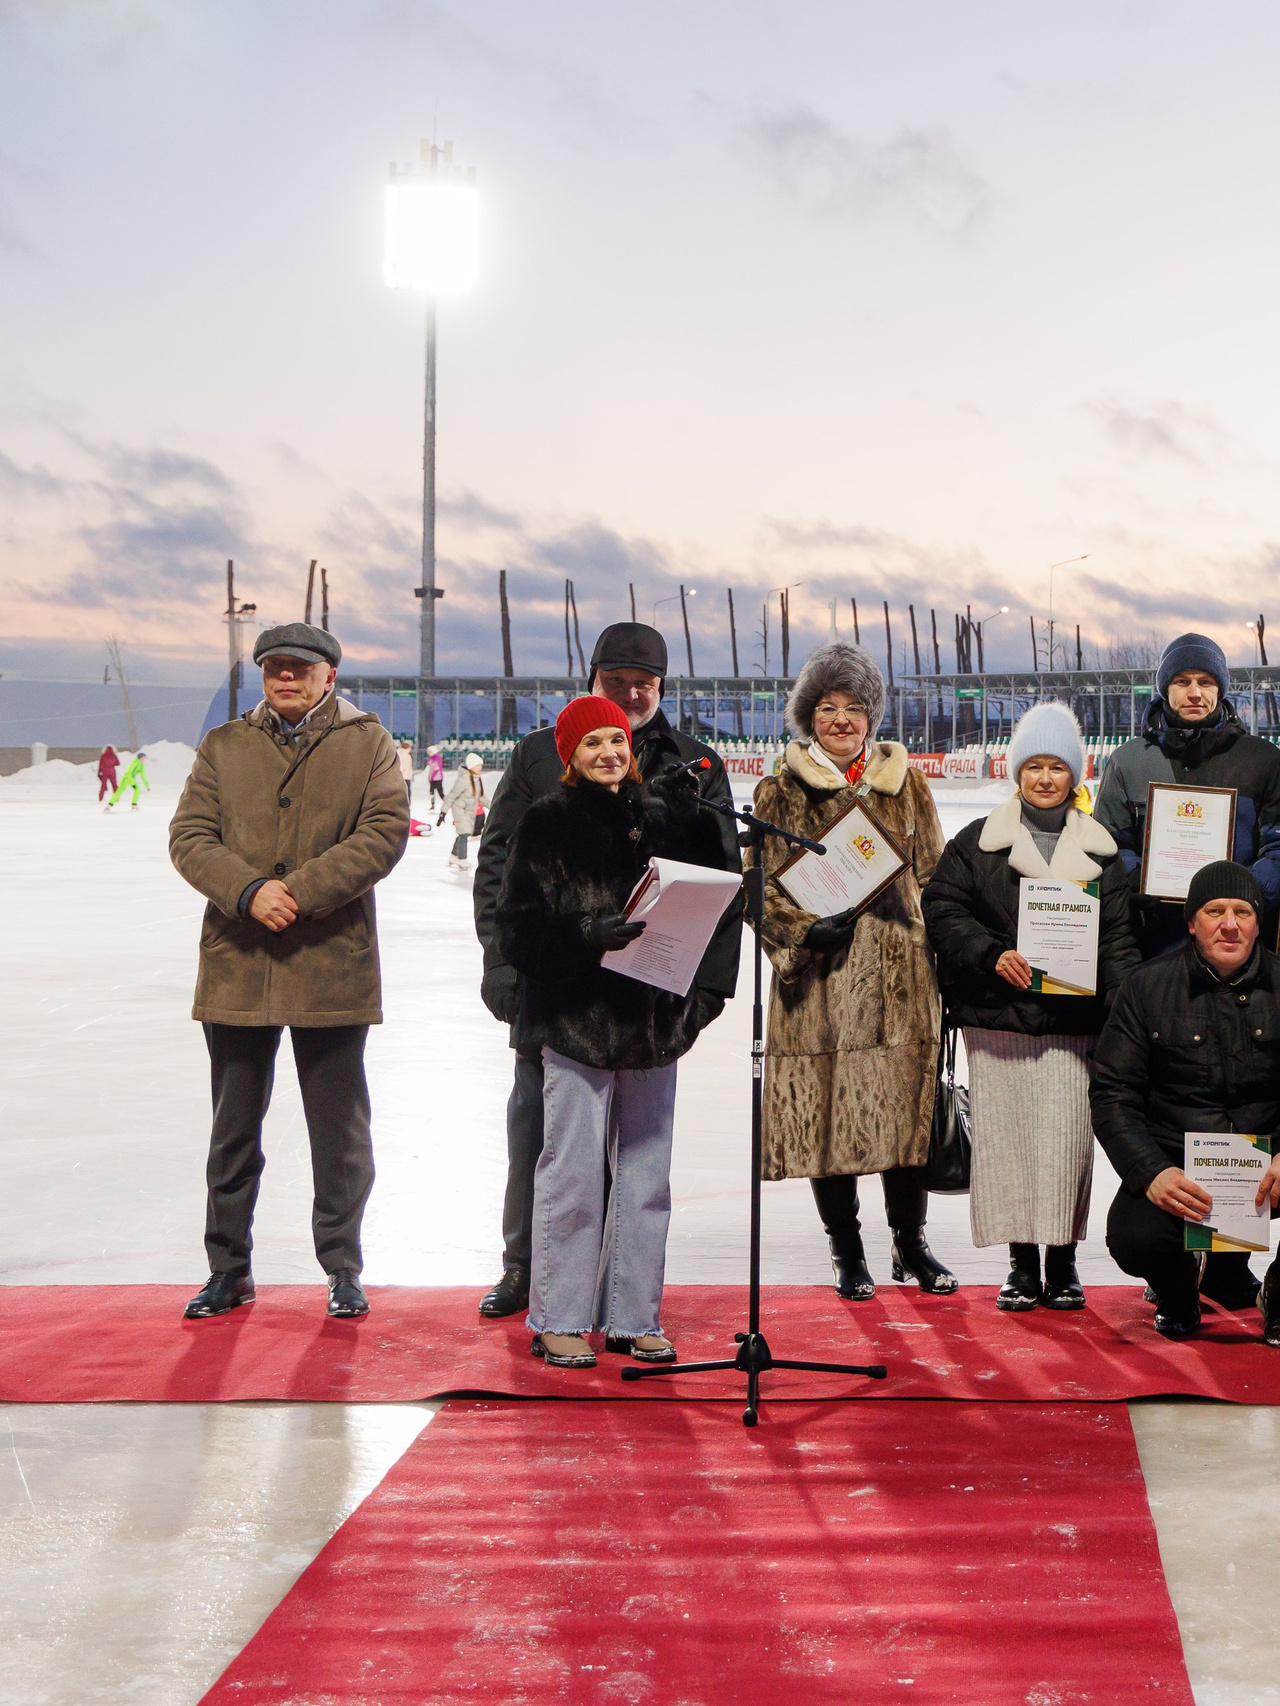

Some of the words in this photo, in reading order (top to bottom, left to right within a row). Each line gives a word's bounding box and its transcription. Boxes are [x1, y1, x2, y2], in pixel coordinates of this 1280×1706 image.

[944, 759, 976, 774] УРАЛА
[1028, 902, 1060, 912] ПОЧЕТНАЯ
[1062, 904, 1092, 913] ГРАМОТА
[1194, 1158, 1229, 1167] ПОЧЕТНАЯ
[1230, 1158, 1262, 1168] ГРАМОТА
